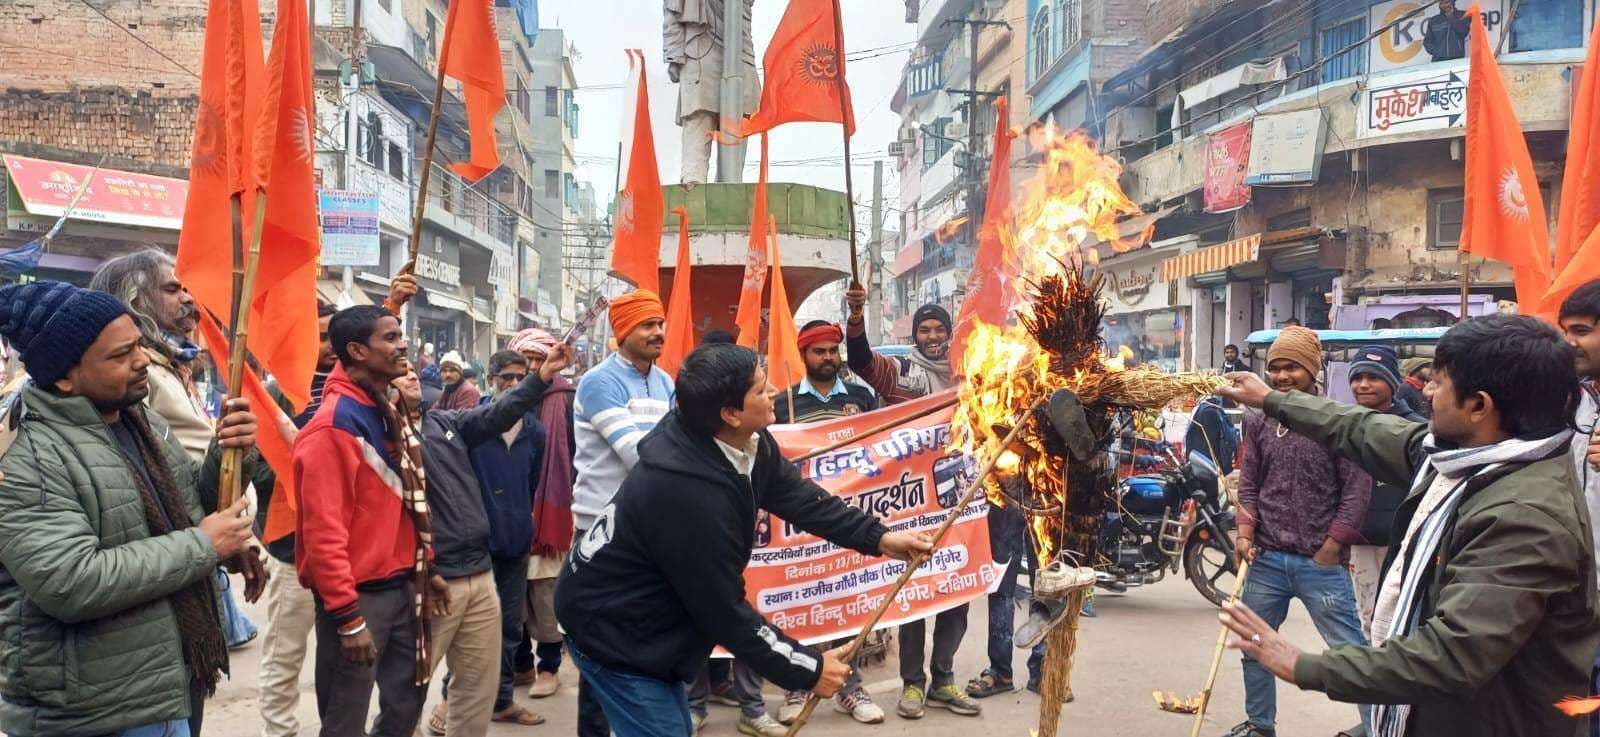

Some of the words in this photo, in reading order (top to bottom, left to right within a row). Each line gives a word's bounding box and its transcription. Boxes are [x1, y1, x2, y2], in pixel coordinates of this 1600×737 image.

[1374, 88, 1424, 131] मुकेश
[808, 446, 881, 479] हिन्दू
[764, 590, 792, 605] स्थान
[802, 580, 832, 599] राजीव
[835, 569, 857, 592] गाँधी
[859, 568, 879, 584] चौक
[934, 549, 962, 570] मुंगेर
[784, 563, 826, 580] दिनांक
[771, 611, 807, 630] विश्व
[811, 603, 847, 626] हिन्दू
[936, 572, 977, 595] दक्षिण
